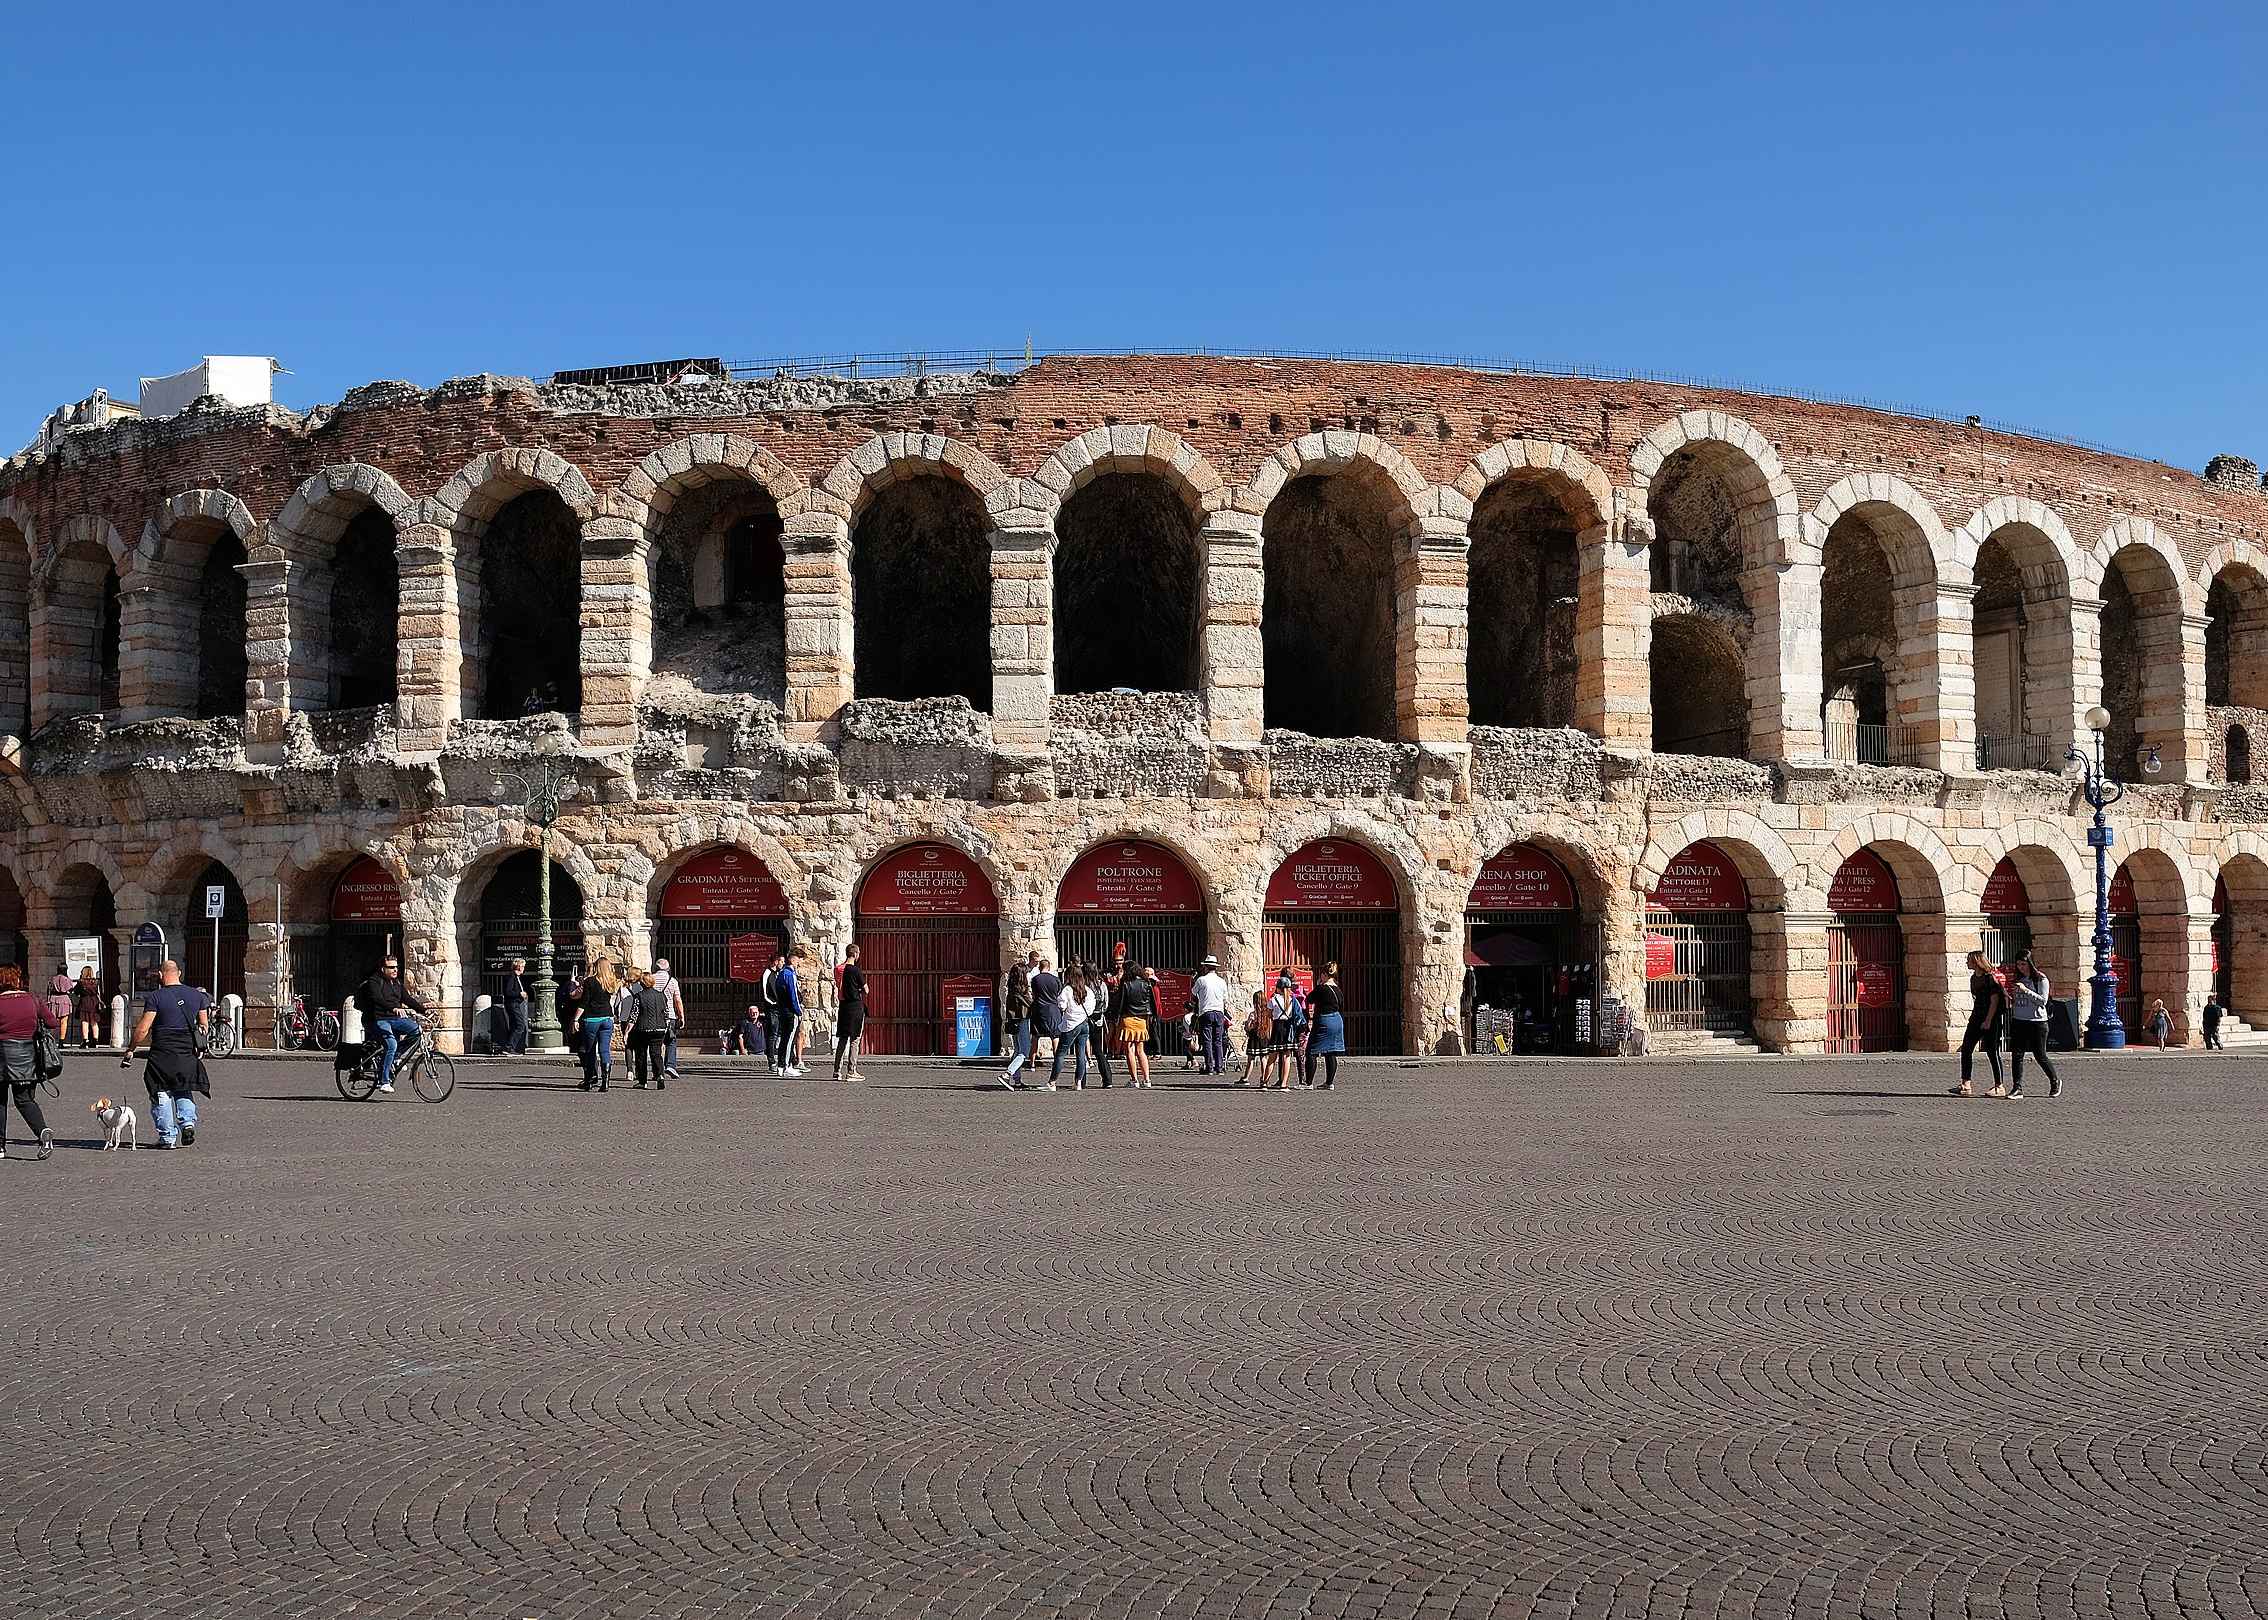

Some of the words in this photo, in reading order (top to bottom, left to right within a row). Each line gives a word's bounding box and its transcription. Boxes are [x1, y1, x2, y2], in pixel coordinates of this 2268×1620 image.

[1097, 867, 1162, 877] POLTRONE
[1295, 864, 1360, 873] BIGLIETTERIA
[1664, 866, 1721, 876] ADINATA
[1838, 867, 1869, 875] ITALITY
[897, 870, 965, 879] BIGLIETTERIA
[1292, 873, 1328, 881] TICKET
[1329, 873, 1362, 881] OFFICE
[1479, 870, 1512, 880] RENA
[1514, 870, 1547, 880] SHOP
[677, 875, 737, 884] GRADINATA
[895, 878, 930, 887] TICKET
[932, 878, 968, 887] OFFICE
[1852, 877, 1876, 885] PRESS
[341, 884, 382, 892] INGRESSO
[1473, 883, 1506, 891] ancello
[1515, 883, 1536, 891] Gate
[1539, 883, 1550, 891] 10
